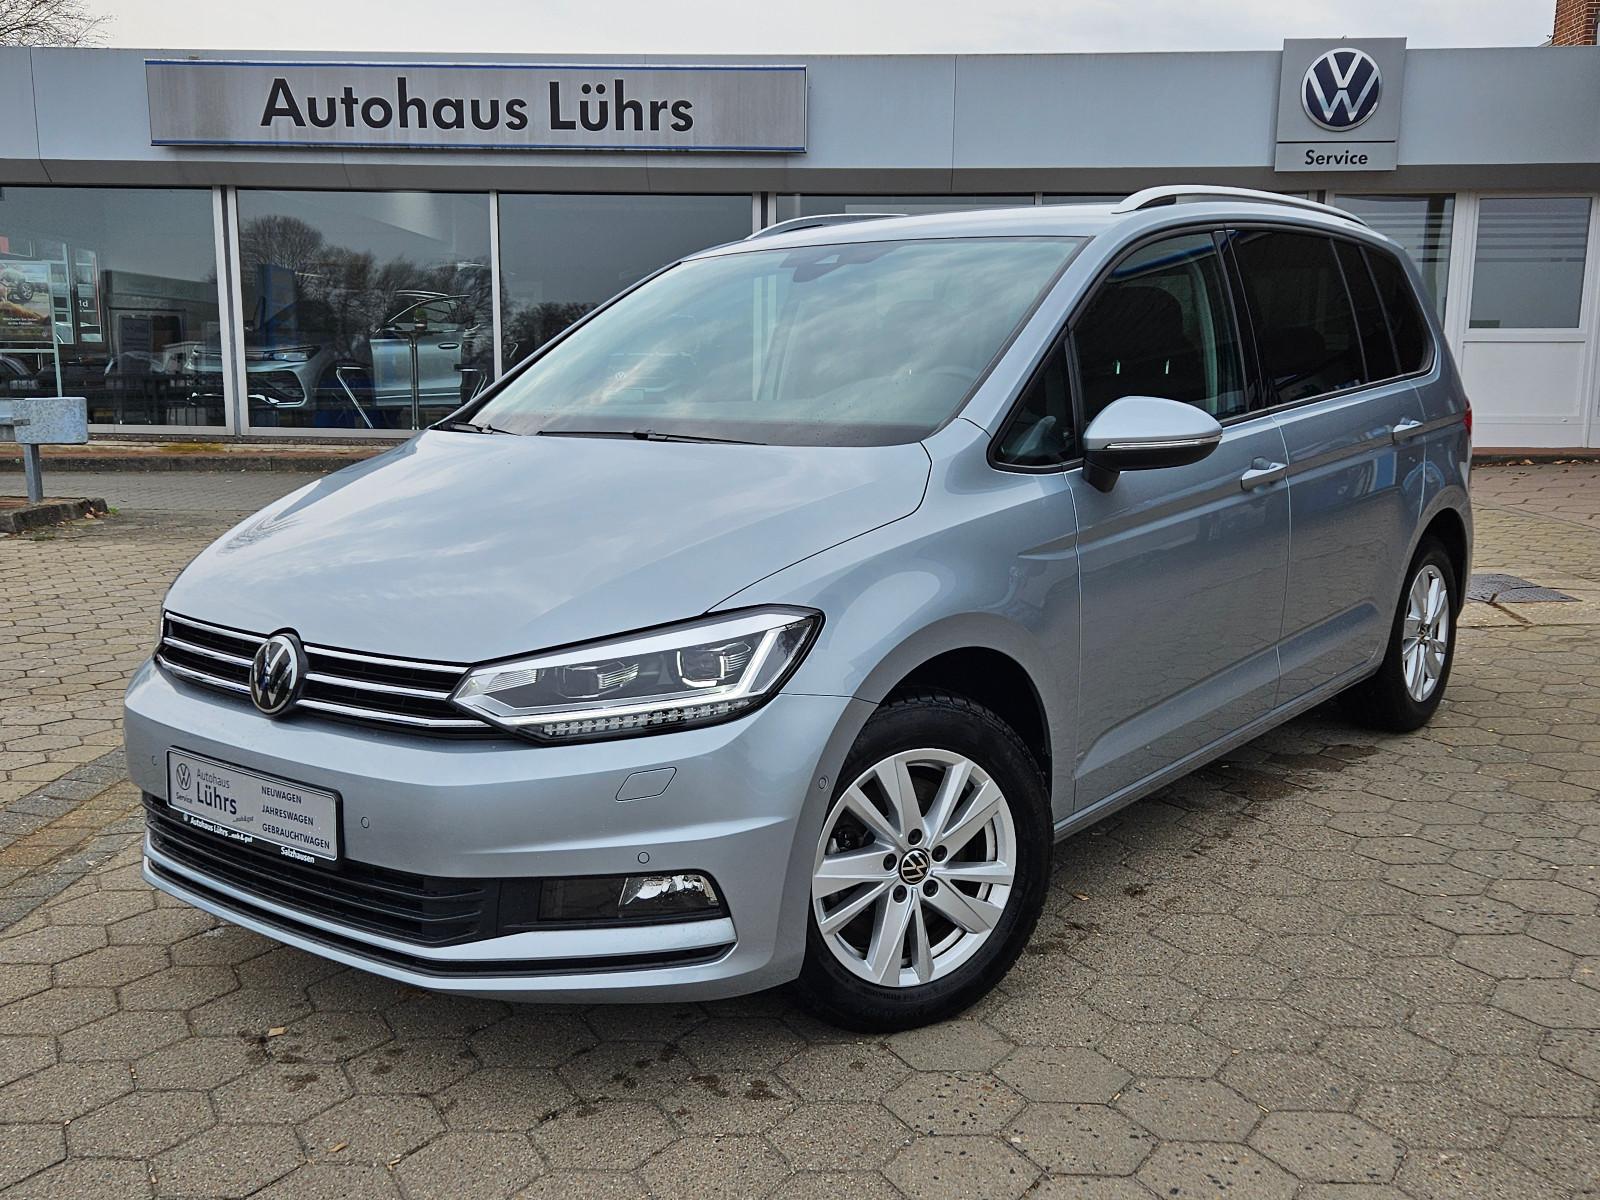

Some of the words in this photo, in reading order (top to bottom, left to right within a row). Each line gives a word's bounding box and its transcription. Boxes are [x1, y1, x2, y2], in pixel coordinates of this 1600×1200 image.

[260, 76, 528, 130] Autohaus
[549, 78, 695, 133] Lührs
[1304, 149, 1369, 166] Service
[196, 767, 231, 790] Autohaus
[197, 781, 238, 815] Lührs
[261, 785, 303, 805] NEUWAGEN
[261, 804, 314, 827] JAHRESWAGEN
[261, 823, 331, 850] GEBRAUCHTWAGEN
[280, 846, 315, 864] Salzhausen
